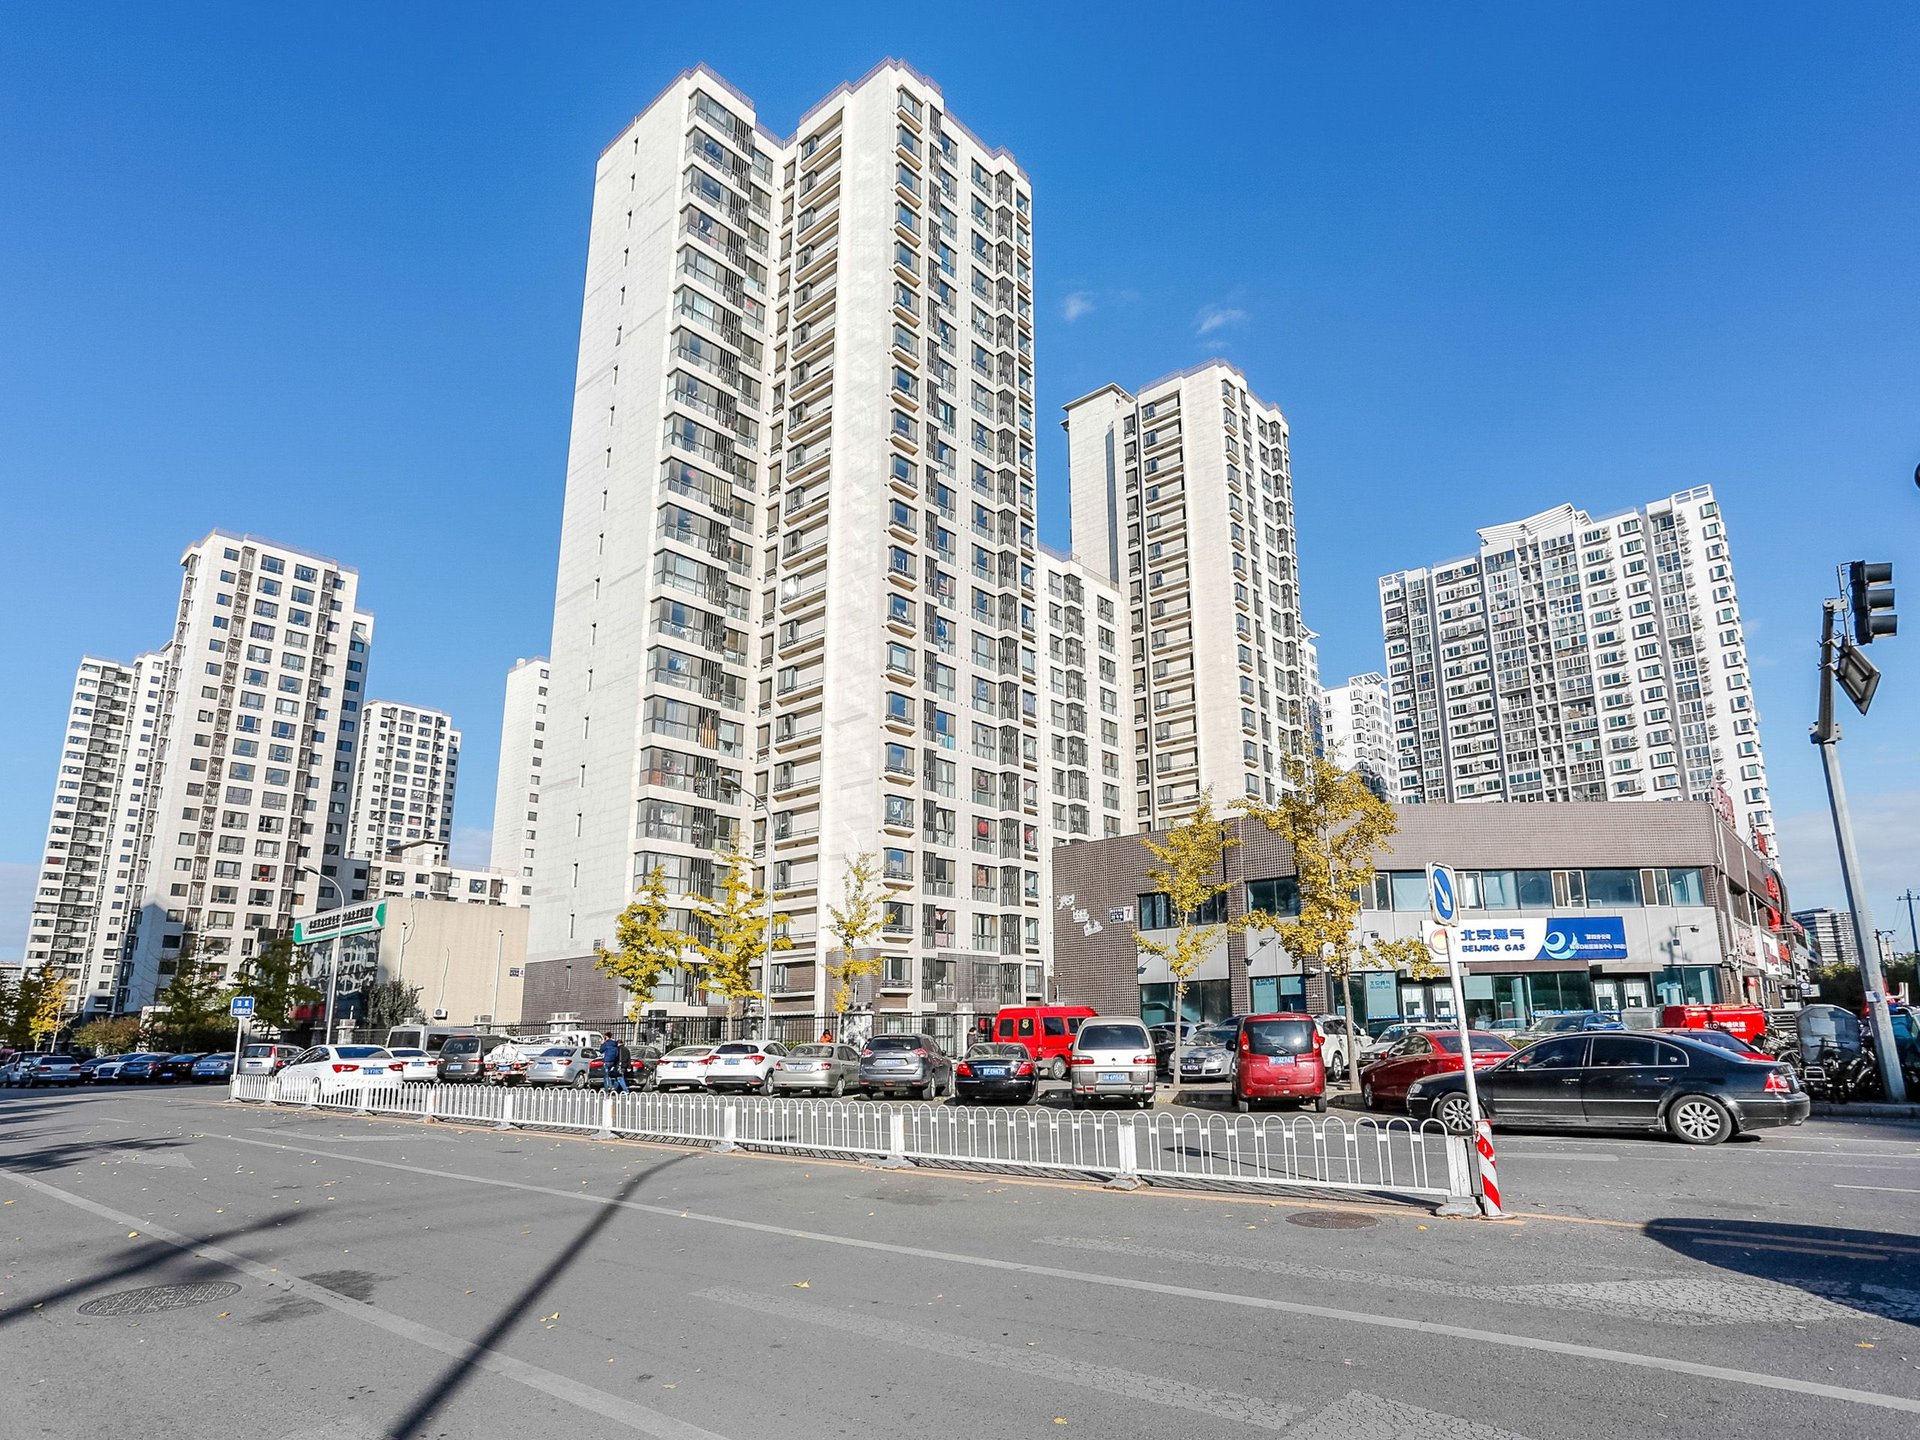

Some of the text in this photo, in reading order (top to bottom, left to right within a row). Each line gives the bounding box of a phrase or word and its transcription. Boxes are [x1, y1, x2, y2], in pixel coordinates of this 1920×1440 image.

[1125, 908, 1131, 919] 7
[1460, 928, 1525, 941] 北京燃气
[1461, 943, 1526, 953] BEIJING GAS
